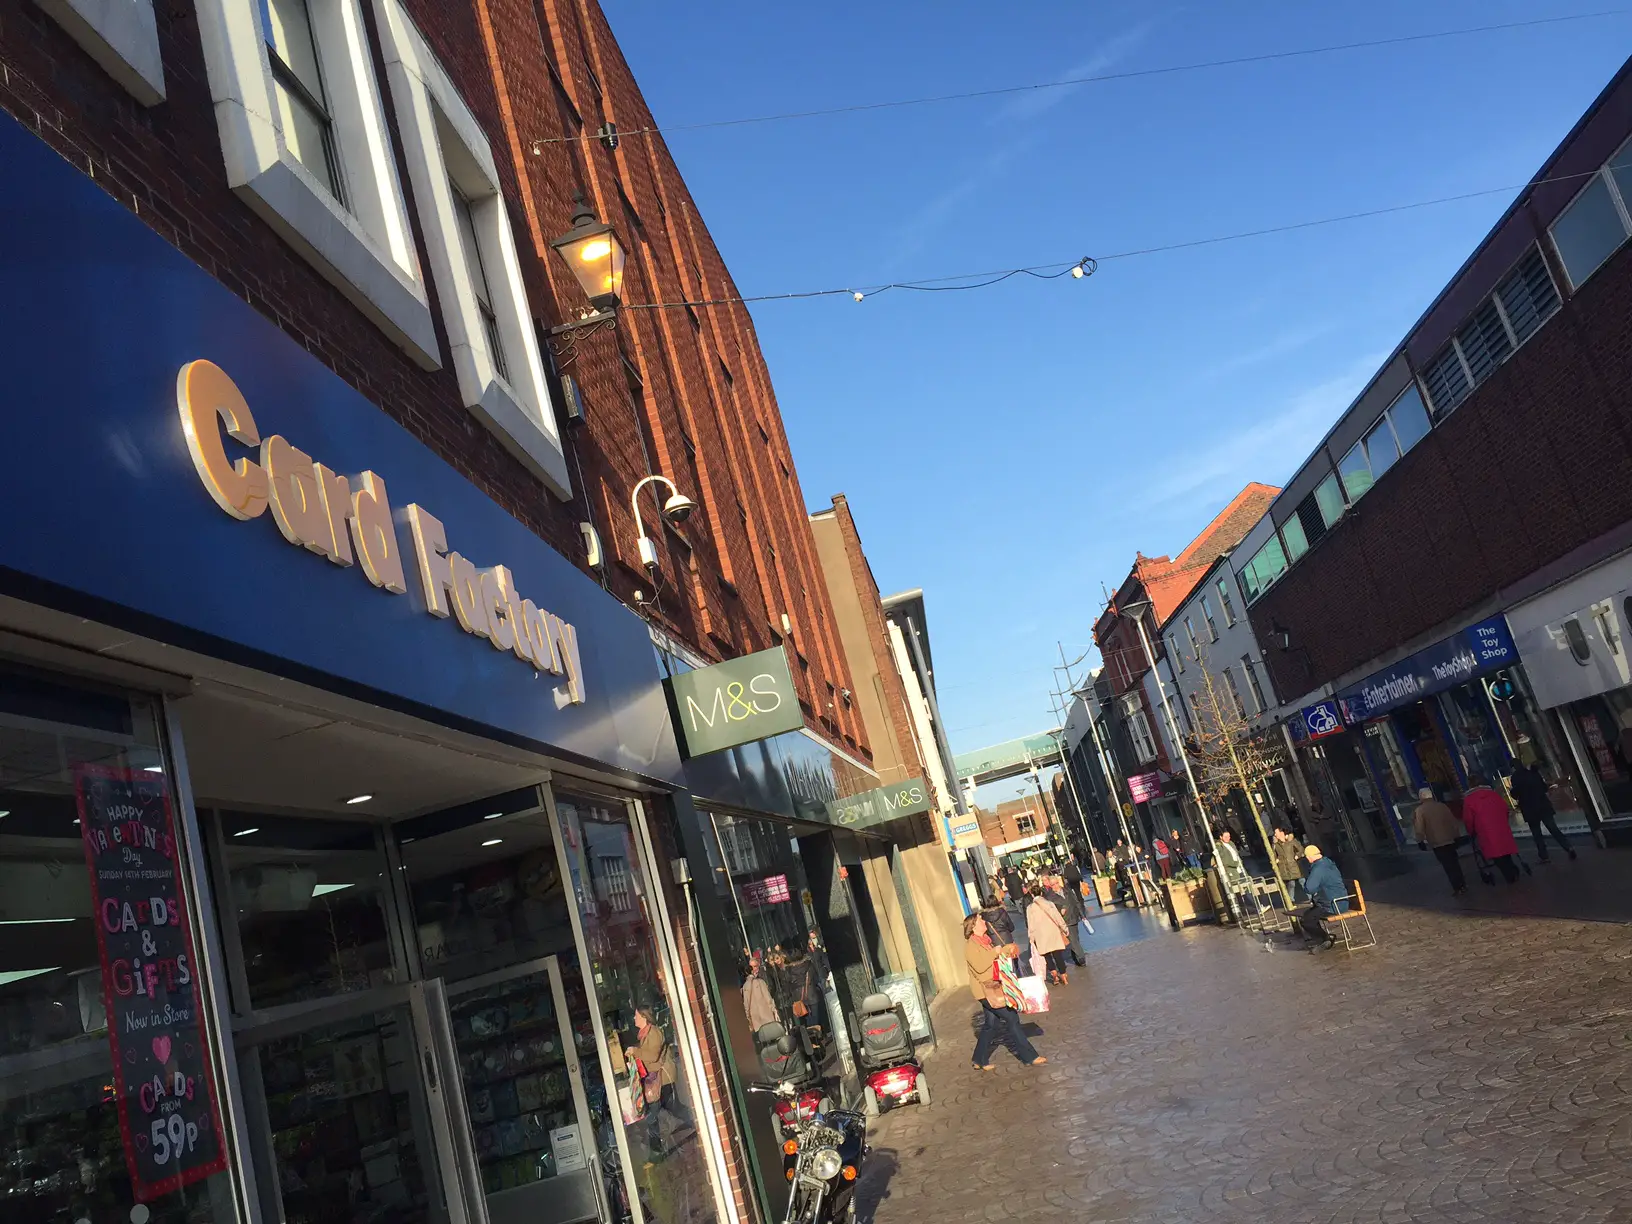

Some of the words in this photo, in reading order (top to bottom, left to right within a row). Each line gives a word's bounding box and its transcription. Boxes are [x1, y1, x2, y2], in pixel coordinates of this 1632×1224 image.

[177, 359, 407, 594] Card
[407, 503, 585, 710] Factory
[1477, 627, 1496, 638] The
[1481, 638, 1499, 648] Toy
[1481, 647, 1508, 660] Shop
[686, 673, 781, 732] M&S
[883, 787, 923, 811] M&S
[106, 804, 143, 822] HAPPY
[955, 823, 977, 833] GREGGS
[122, 847, 143, 867] Day
[99, 870, 123, 880] SUNDAY
[141, 869, 172, 879] FEBRUARY
[142, 930, 158, 956] &
[125, 1010, 148, 1033] Now
[151, 1009, 161, 1026] in
[163, 1004, 190, 1025] Store
[140, 1071, 195, 1113] CADS
[160, 1099, 182, 1112] FROM
